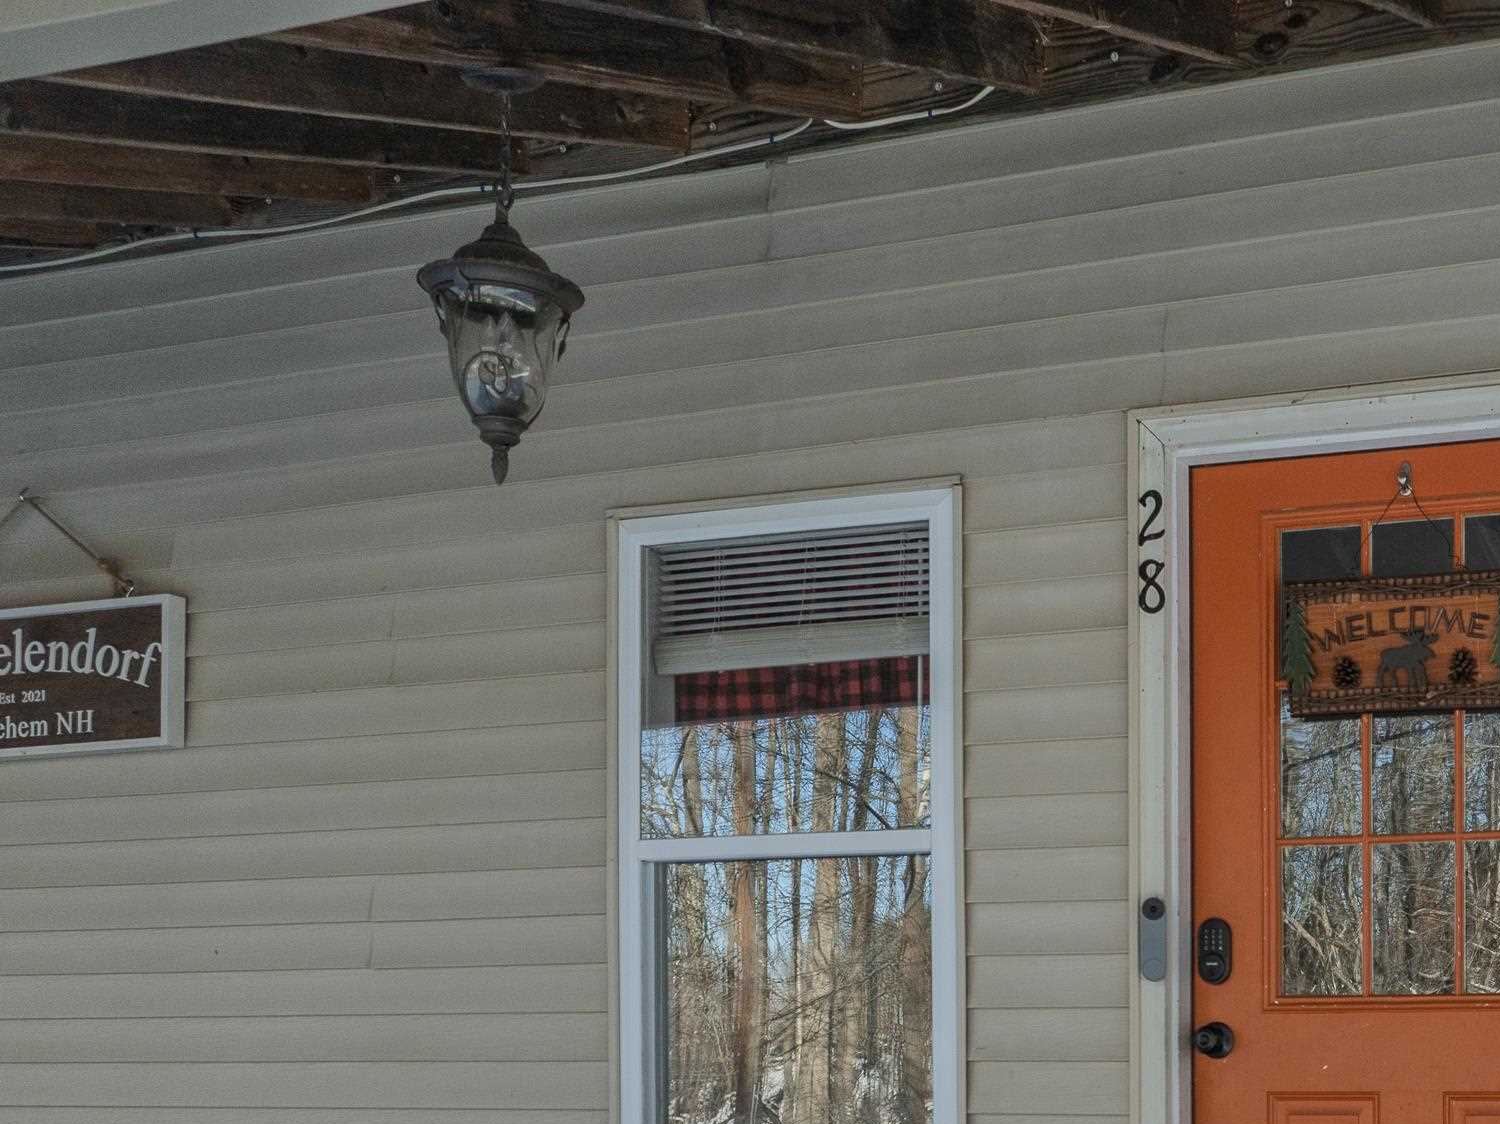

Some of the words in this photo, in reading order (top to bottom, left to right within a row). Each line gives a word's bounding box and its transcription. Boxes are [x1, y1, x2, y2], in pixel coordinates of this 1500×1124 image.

[1138, 489, 1165, 614] 28
[1311, 606, 1490, 652] WELCOME
[21, 690, 46, 703] 2021
[55, 709, 95, 735] NH
